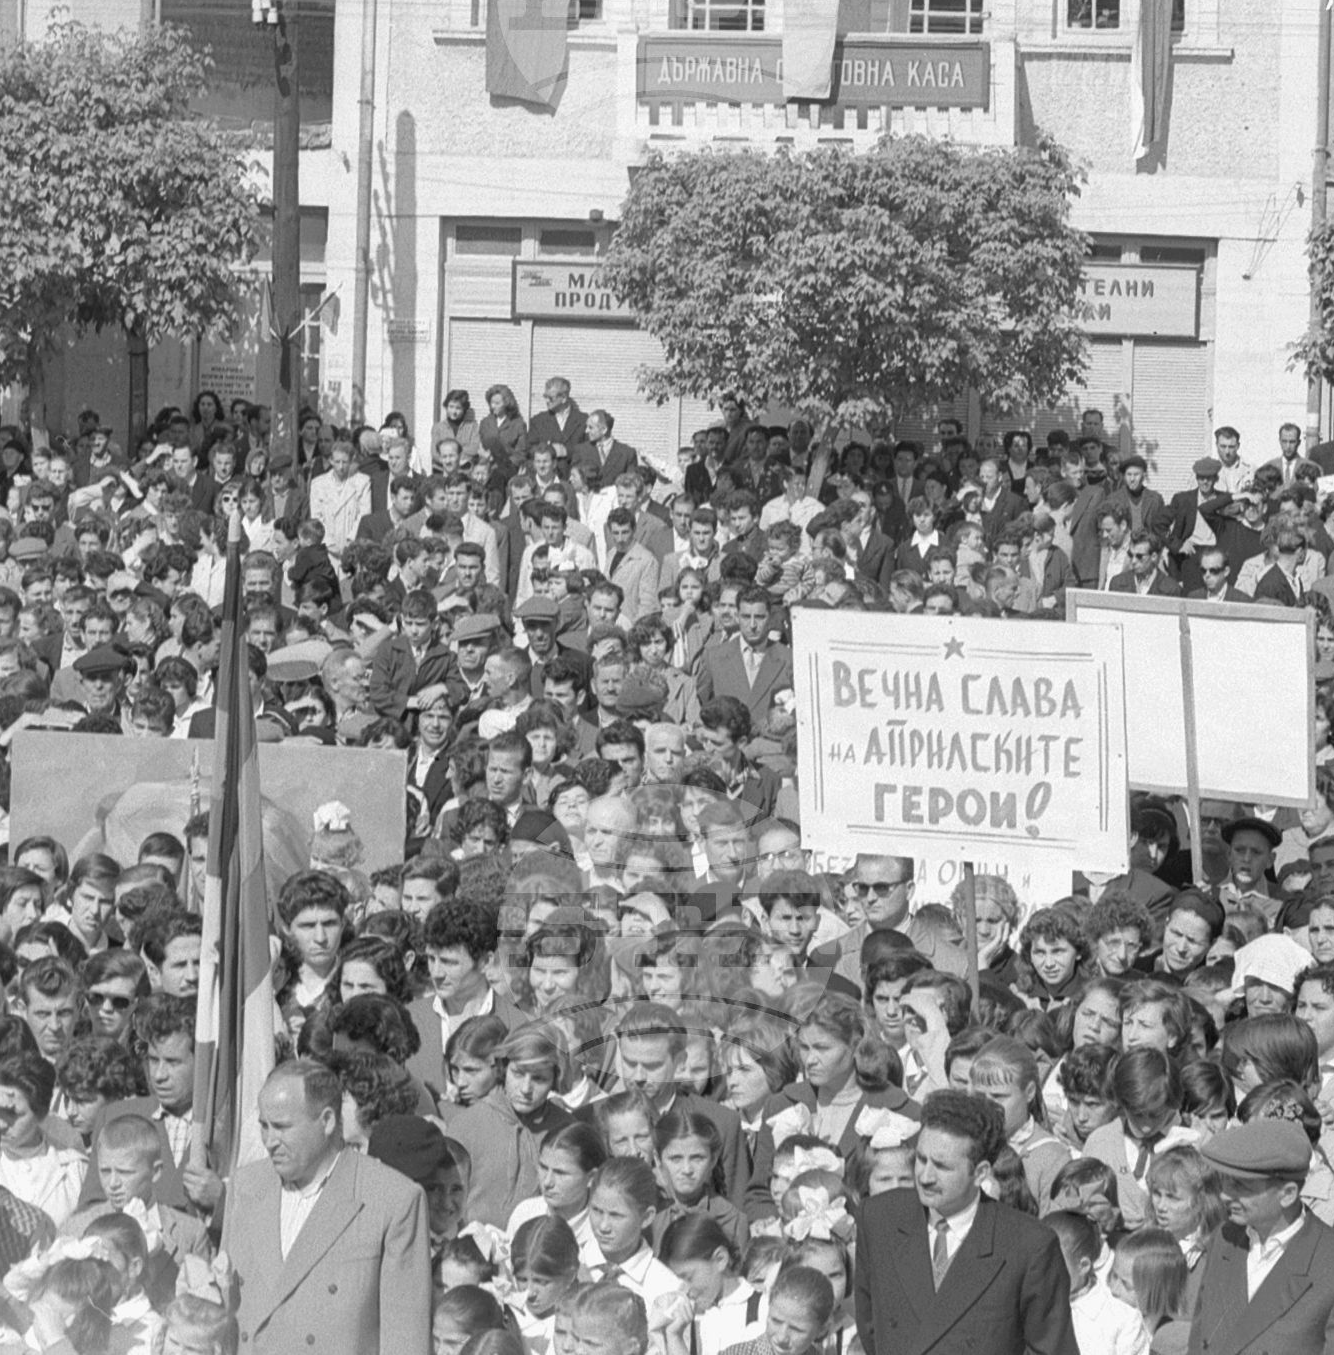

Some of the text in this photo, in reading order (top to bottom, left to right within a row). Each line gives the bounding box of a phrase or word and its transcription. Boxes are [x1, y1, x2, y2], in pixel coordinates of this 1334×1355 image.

[658, 56, 764, 85] ДЪРЖАВНА
[907, 60, 965, 88] КАСА
[832, 659, 1084, 719] ВЕЧНА СЛАВА
[863, 719, 1085, 779] АПРИЛСКИТЕ
[873, 781, 1053, 838] ГЕРОИ!
